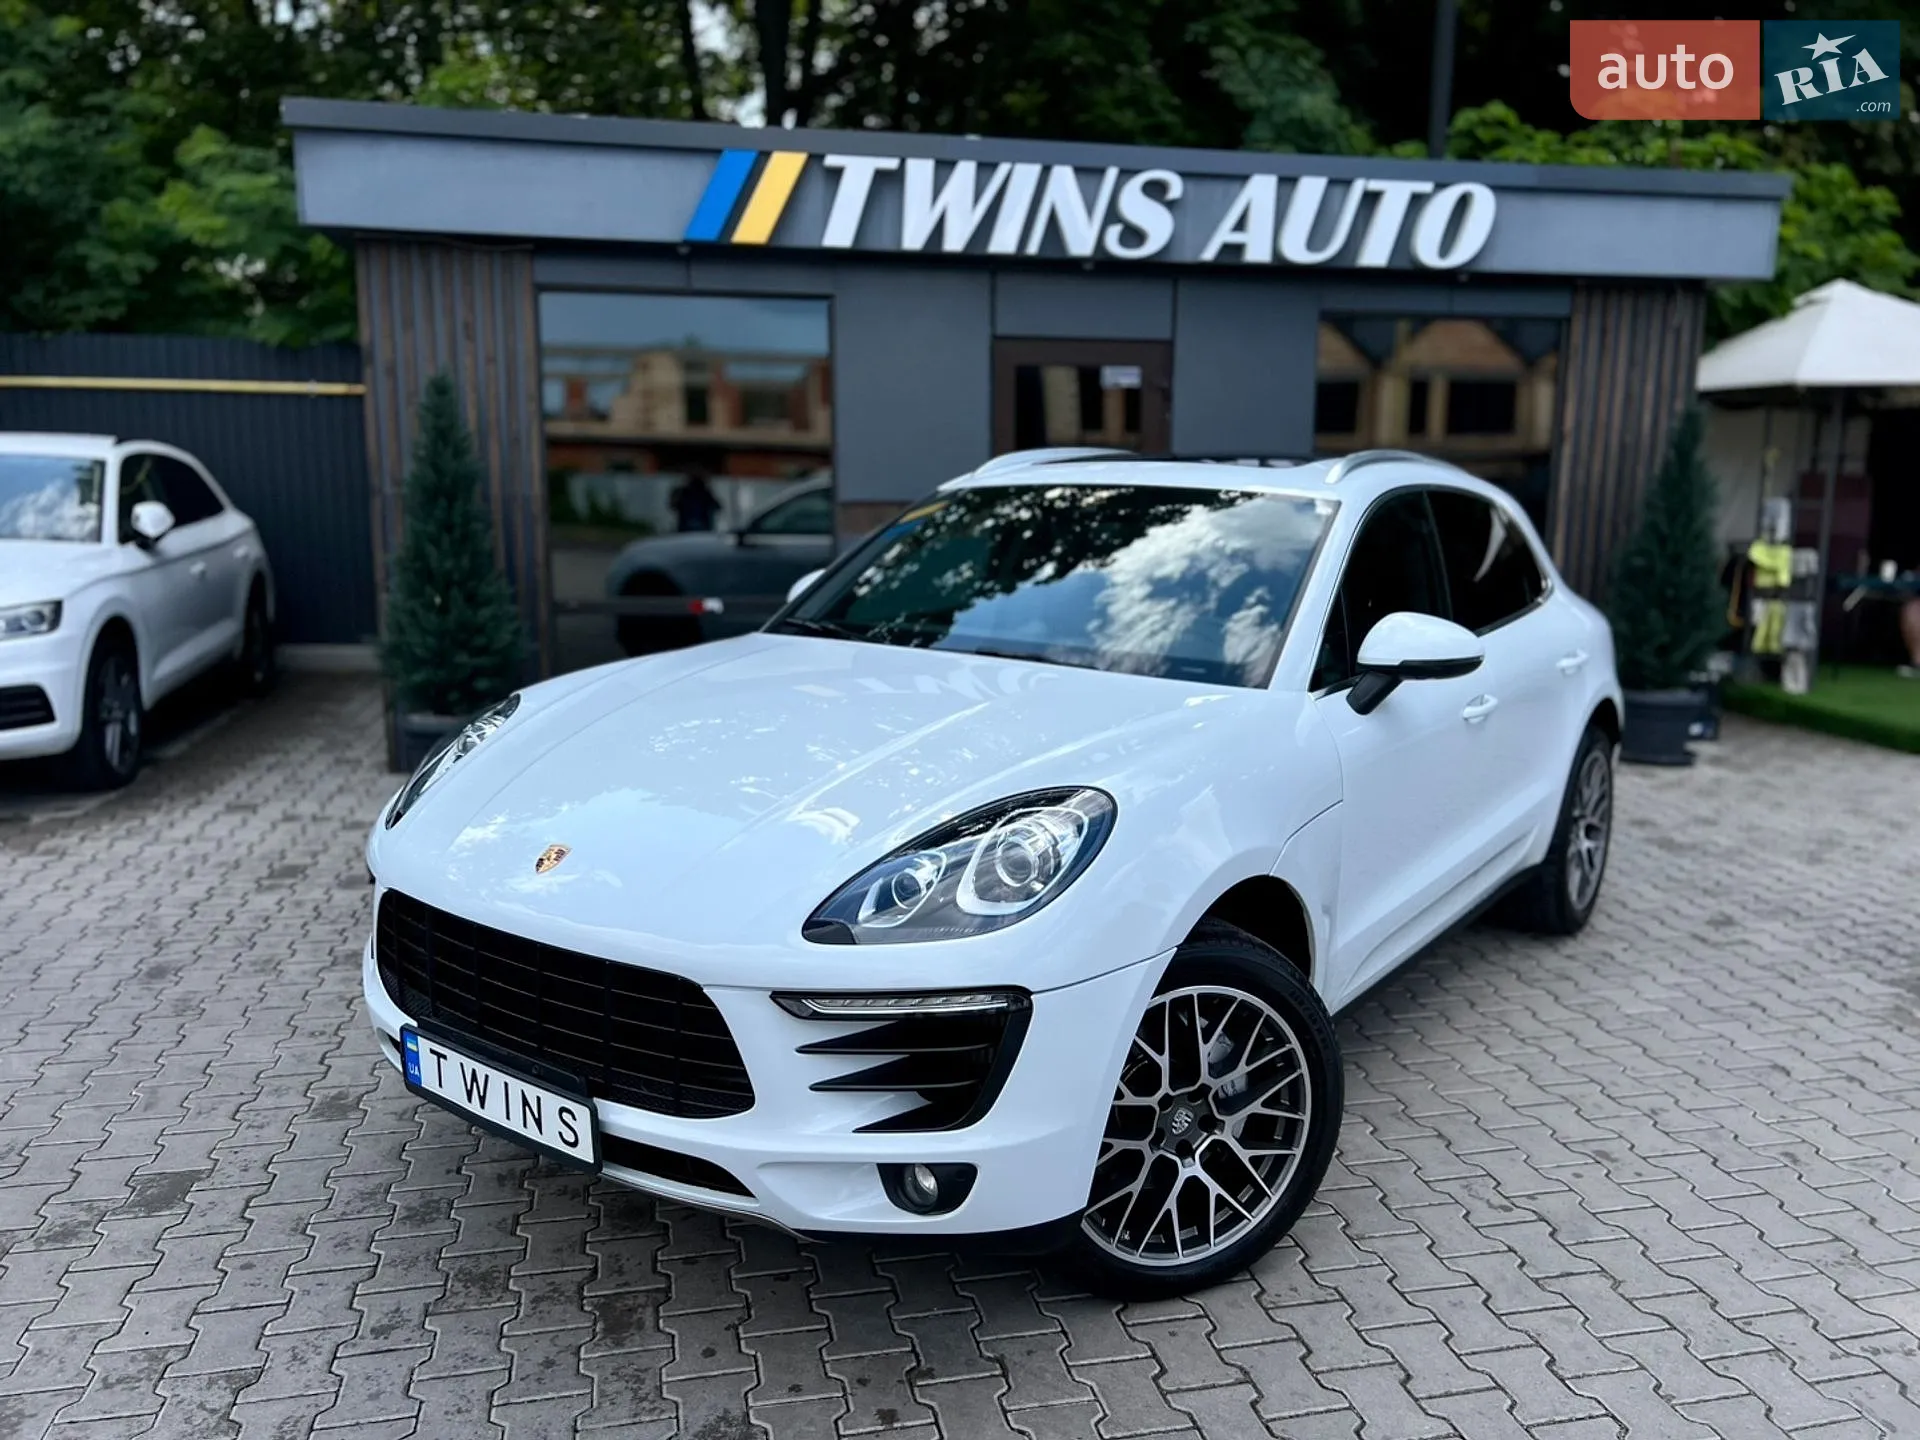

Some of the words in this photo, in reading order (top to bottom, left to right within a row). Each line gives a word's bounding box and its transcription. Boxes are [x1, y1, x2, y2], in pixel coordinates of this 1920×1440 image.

[822, 154, 1184, 259] TWINS
[1201, 174, 1498, 271] AUTO
[408, 1062, 420, 1077] UA
[429, 1048, 579, 1148] TWINS
